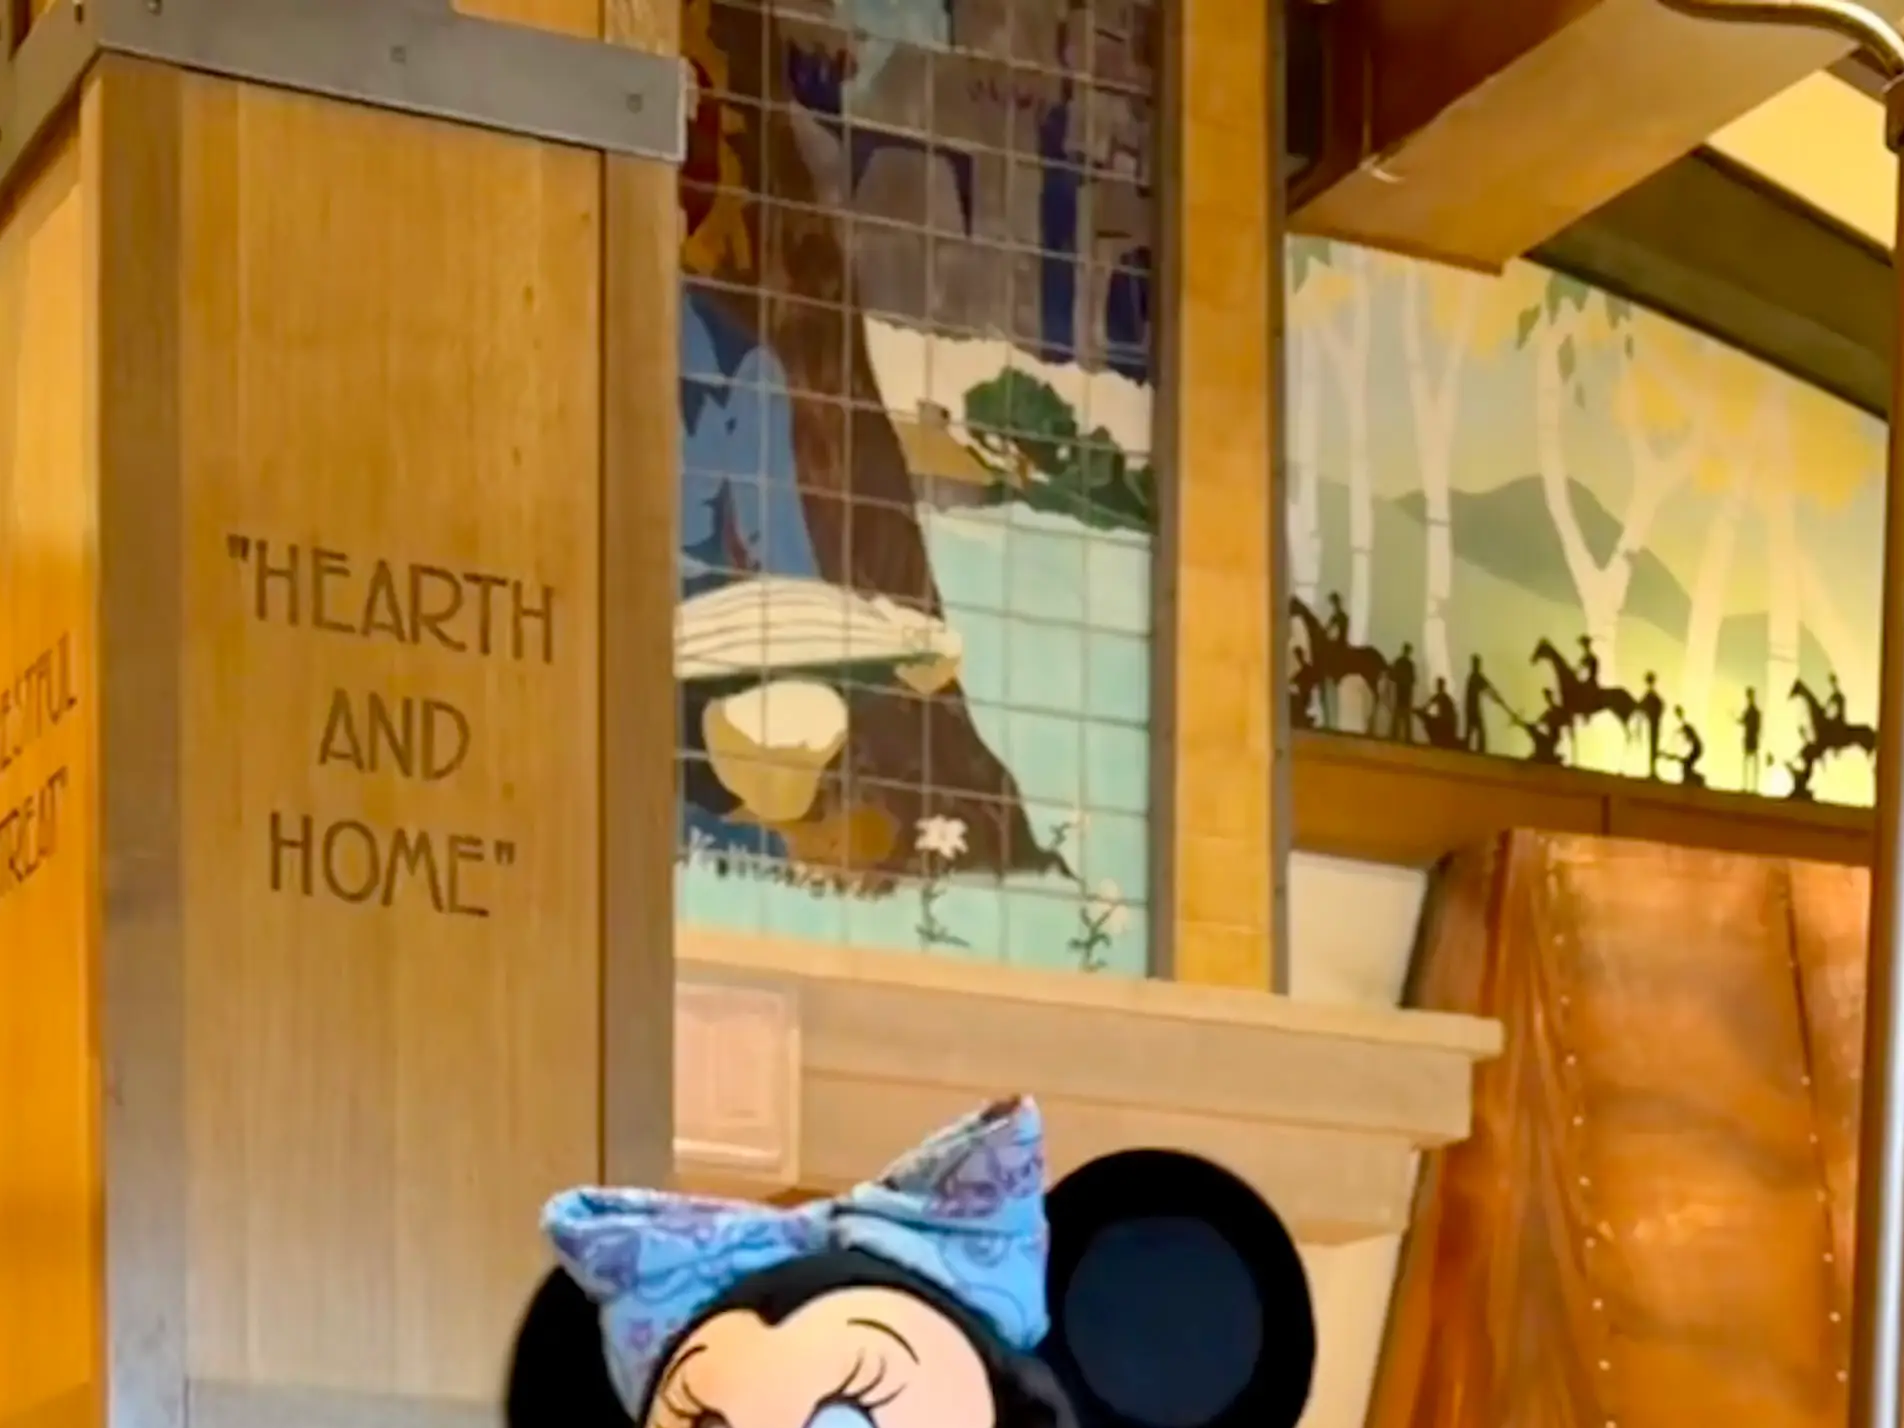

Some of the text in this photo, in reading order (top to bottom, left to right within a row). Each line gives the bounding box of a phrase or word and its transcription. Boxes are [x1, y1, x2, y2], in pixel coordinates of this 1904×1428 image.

[227, 533, 555, 664] "HEARTH
[318, 689, 470, 780] AND
[269, 812, 516, 917] HOME"
